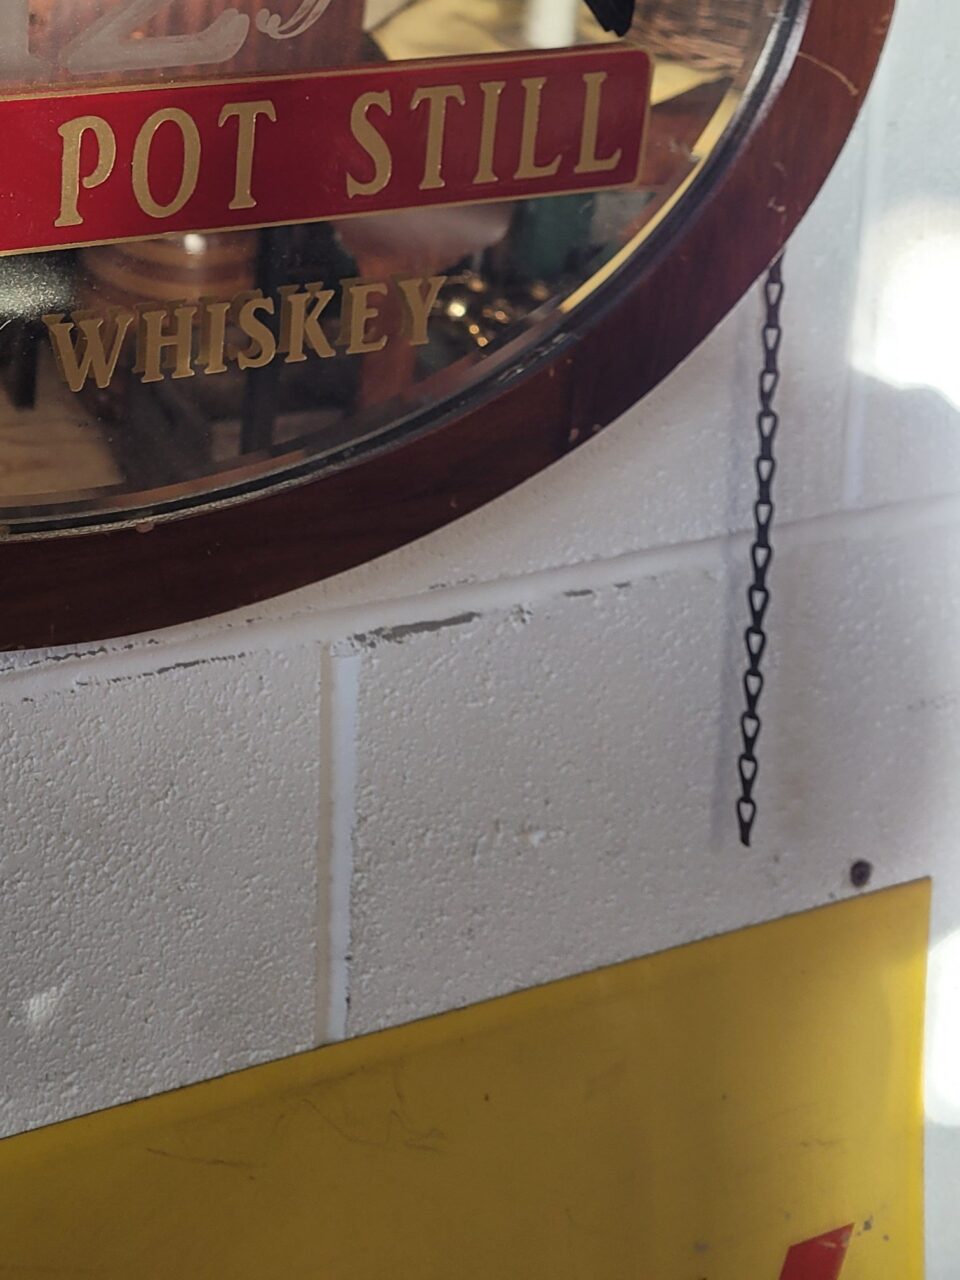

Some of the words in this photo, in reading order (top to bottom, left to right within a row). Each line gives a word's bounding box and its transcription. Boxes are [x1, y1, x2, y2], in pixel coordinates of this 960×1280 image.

[54, 100, 276, 227] POT
[346, 71, 622, 199] STILL
[42, 275, 447, 393] WHISKEY
